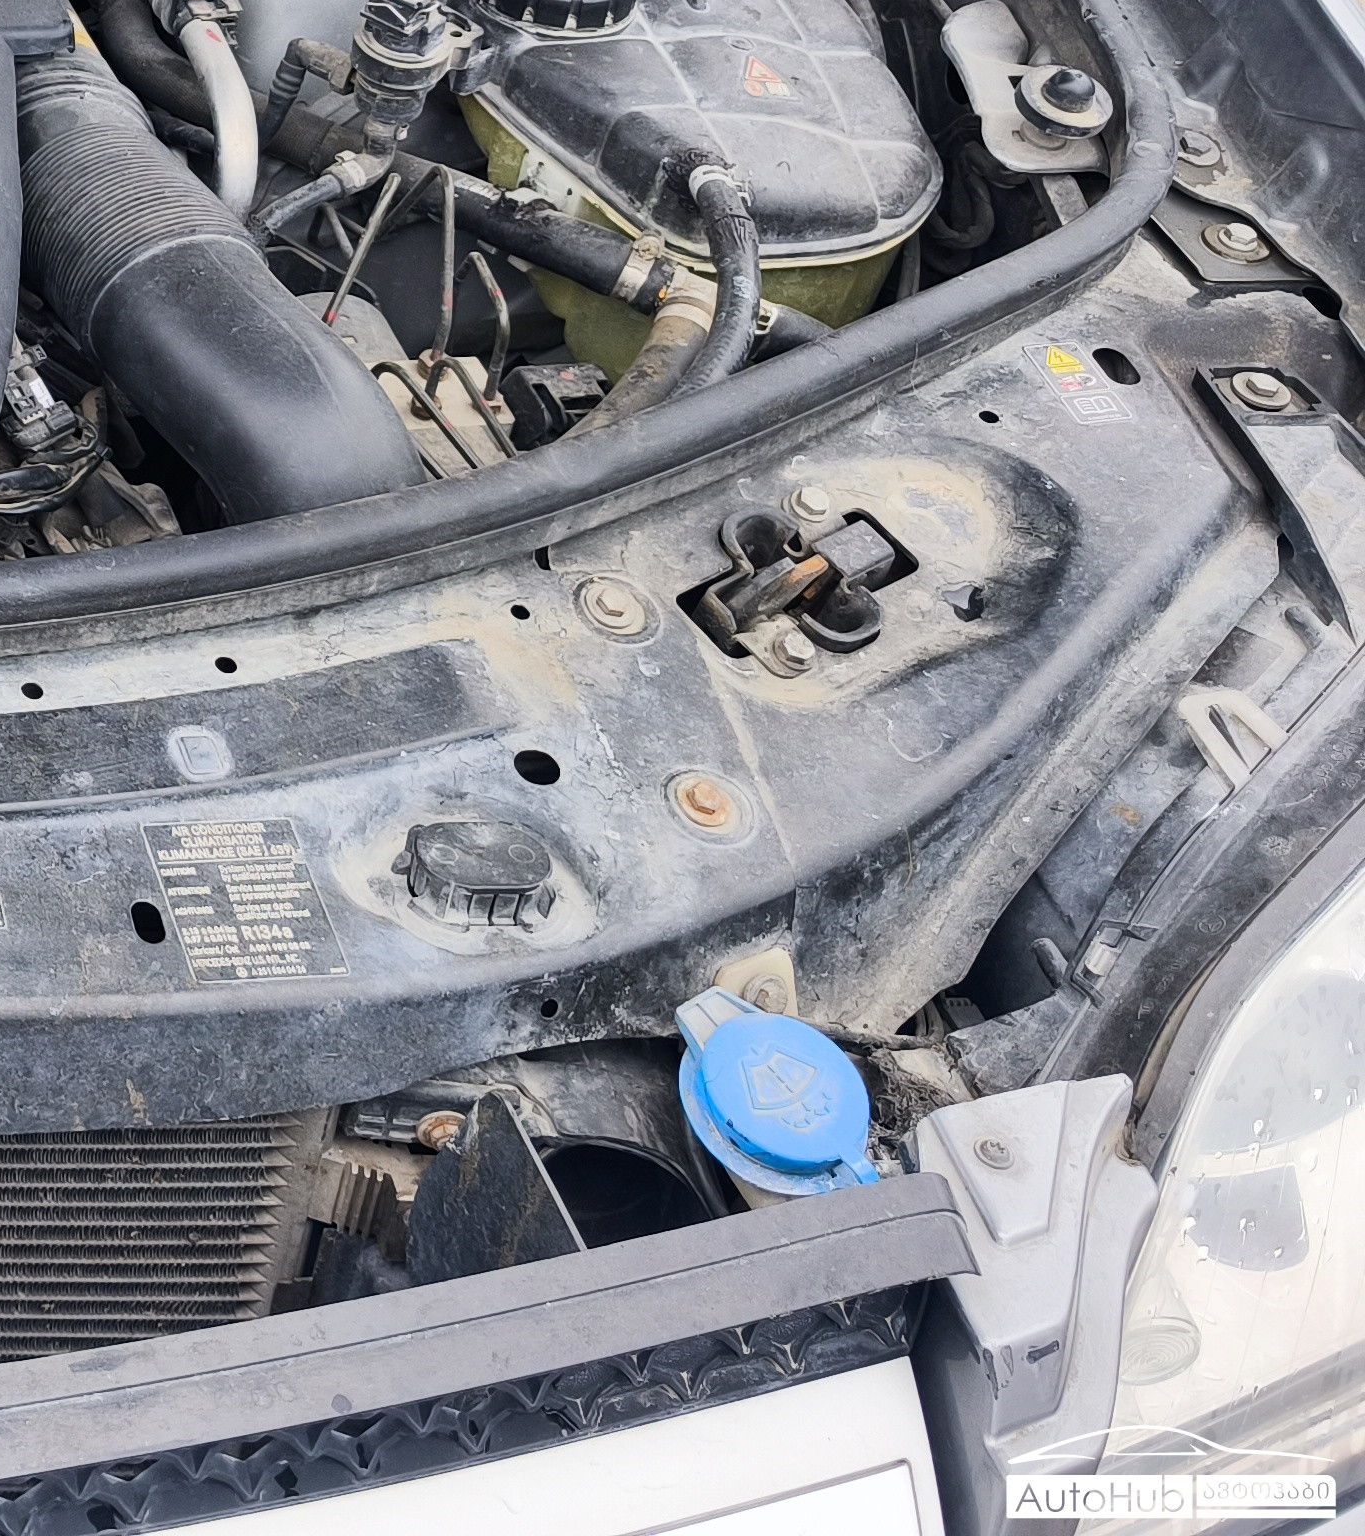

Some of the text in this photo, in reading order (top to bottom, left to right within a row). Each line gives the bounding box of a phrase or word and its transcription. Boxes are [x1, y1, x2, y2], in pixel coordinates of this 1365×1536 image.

[171, 822, 266, 837] AIR CONDITIONER
[180, 833, 264, 848] CLIMATISATION
[157, 847, 236, 861] KLIMAANLAGE
[237, 845, 262, 859] (SAE
[240, 923, 294, 941] R134a
